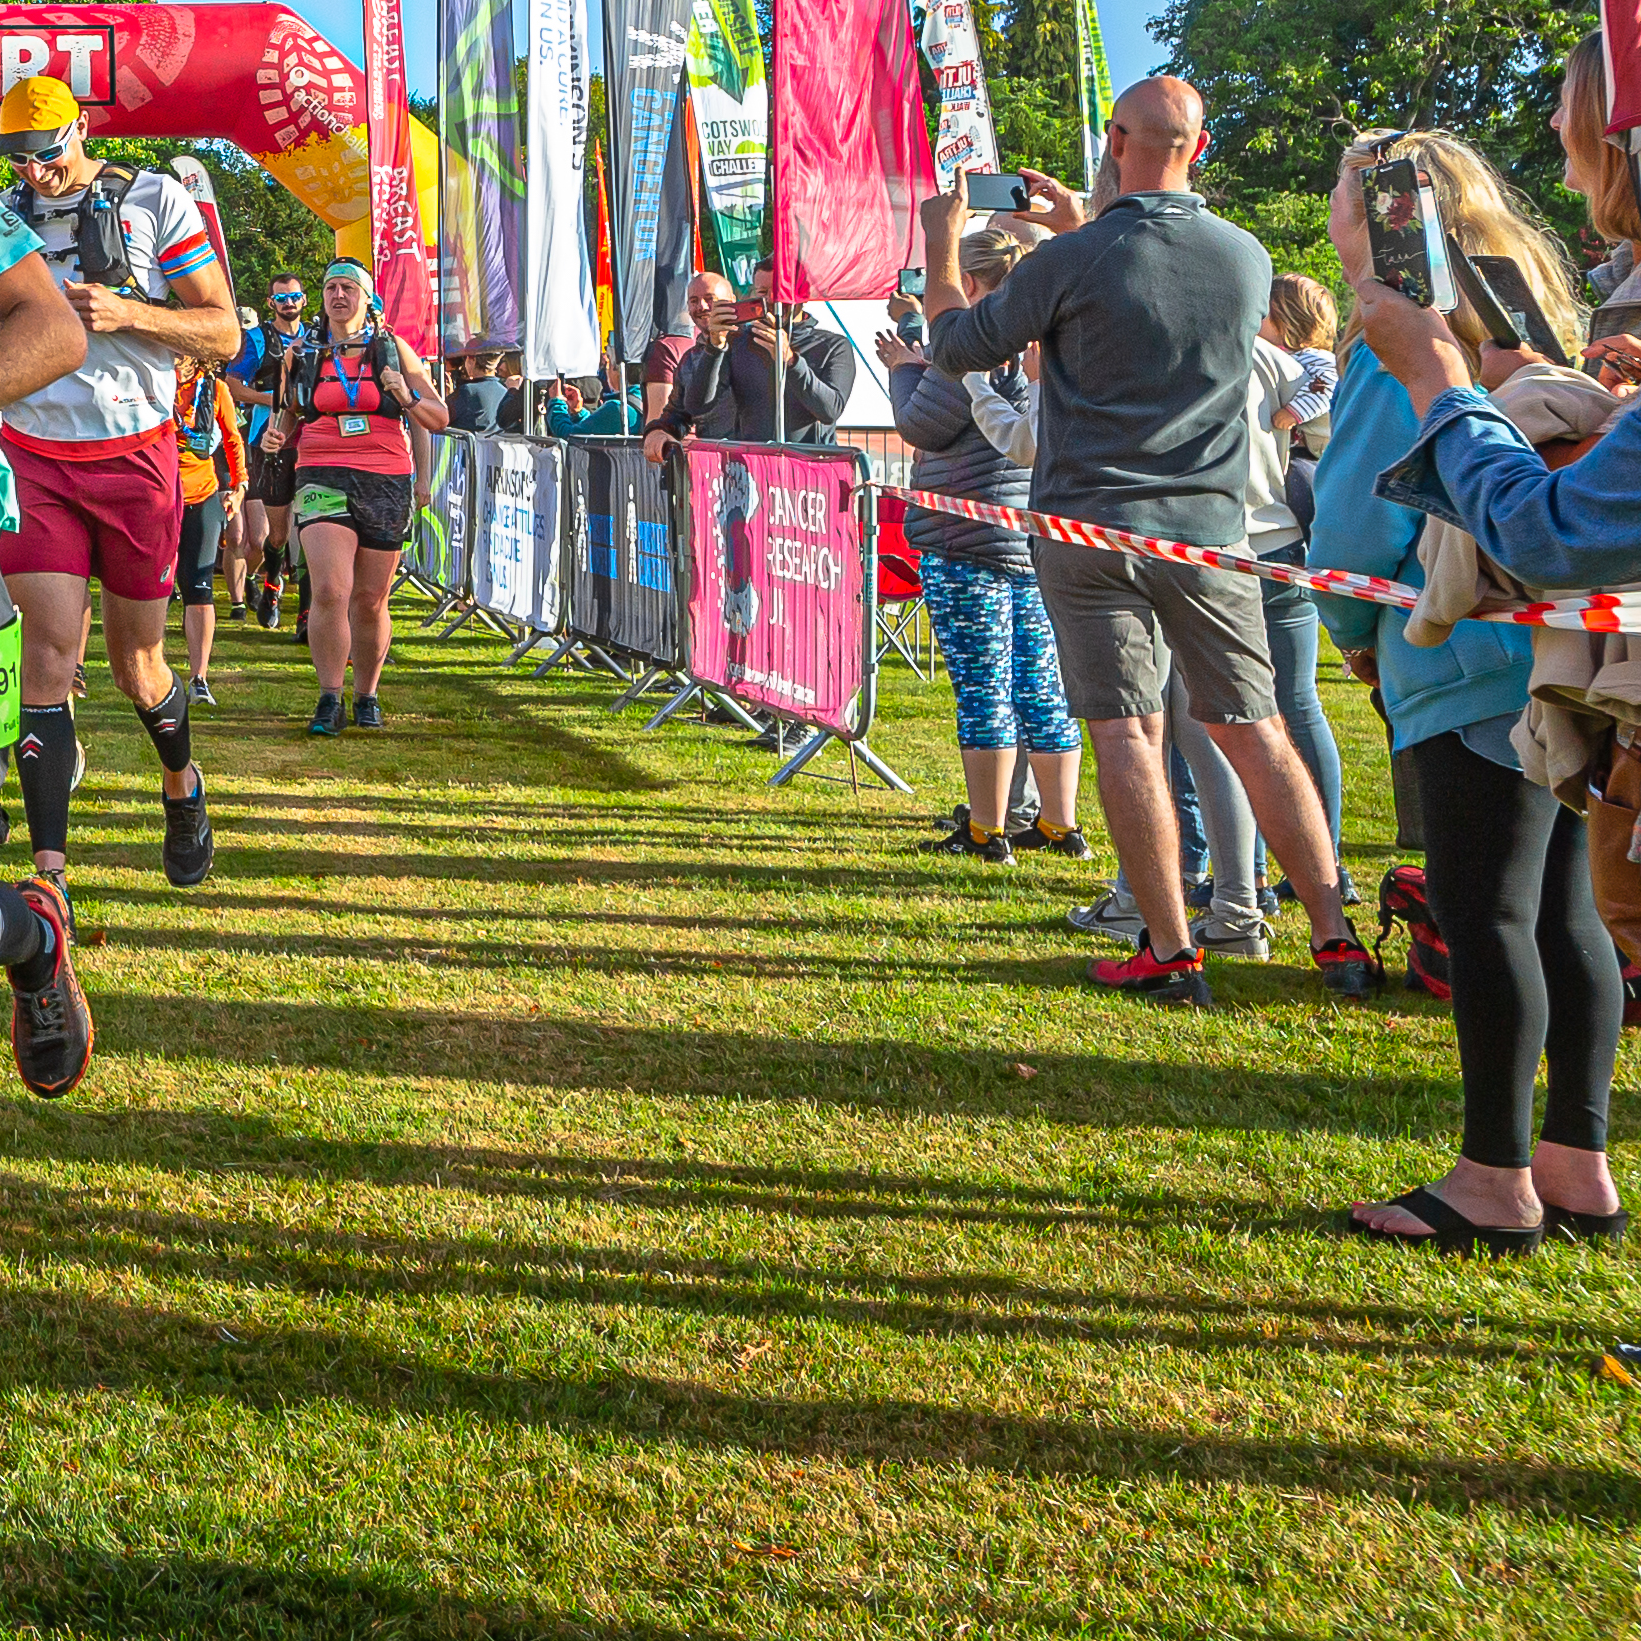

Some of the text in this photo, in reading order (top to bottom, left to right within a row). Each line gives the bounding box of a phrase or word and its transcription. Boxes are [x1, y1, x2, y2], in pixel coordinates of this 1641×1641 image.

[538, 25, 555, 67] US.
[293, 88, 368, 160] actionchall
[701, 119, 767, 140] COTSWO
[708, 139, 732, 157] WAY
[628, 87, 660, 262] CANCER UK
[712, 159, 759, 175] CHALLE
[388, 164, 422, 263] BREAST
[768, 485, 827, 535] CANCER
[767, 537, 843, 590] RESEARCH
